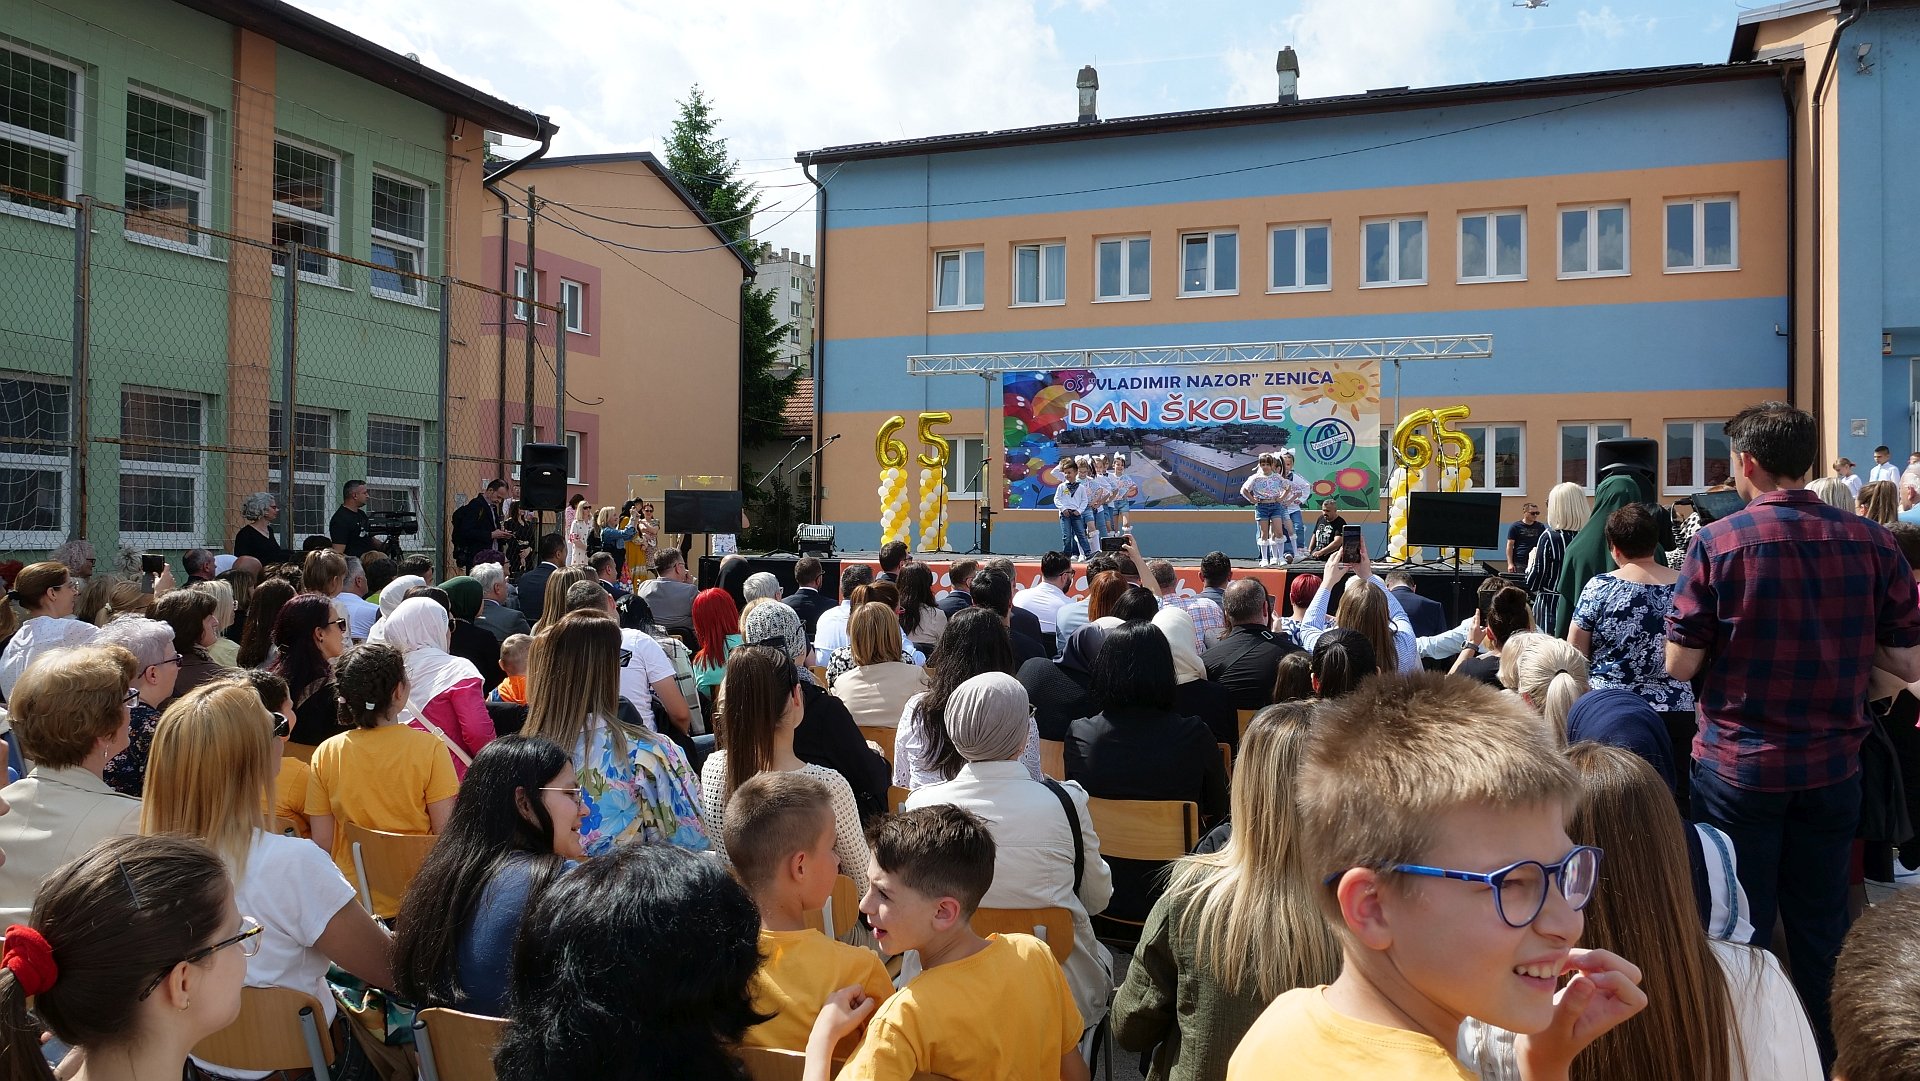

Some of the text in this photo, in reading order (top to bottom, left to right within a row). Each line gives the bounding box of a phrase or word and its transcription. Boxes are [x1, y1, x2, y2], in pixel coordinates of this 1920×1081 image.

[1064, 371, 1334, 392] OŠ "VLADIMIR NAZOR" ZENICA
[1070, 393, 1285, 424] DAN ŠKOLE
[1393, 405, 1474, 468] 65
